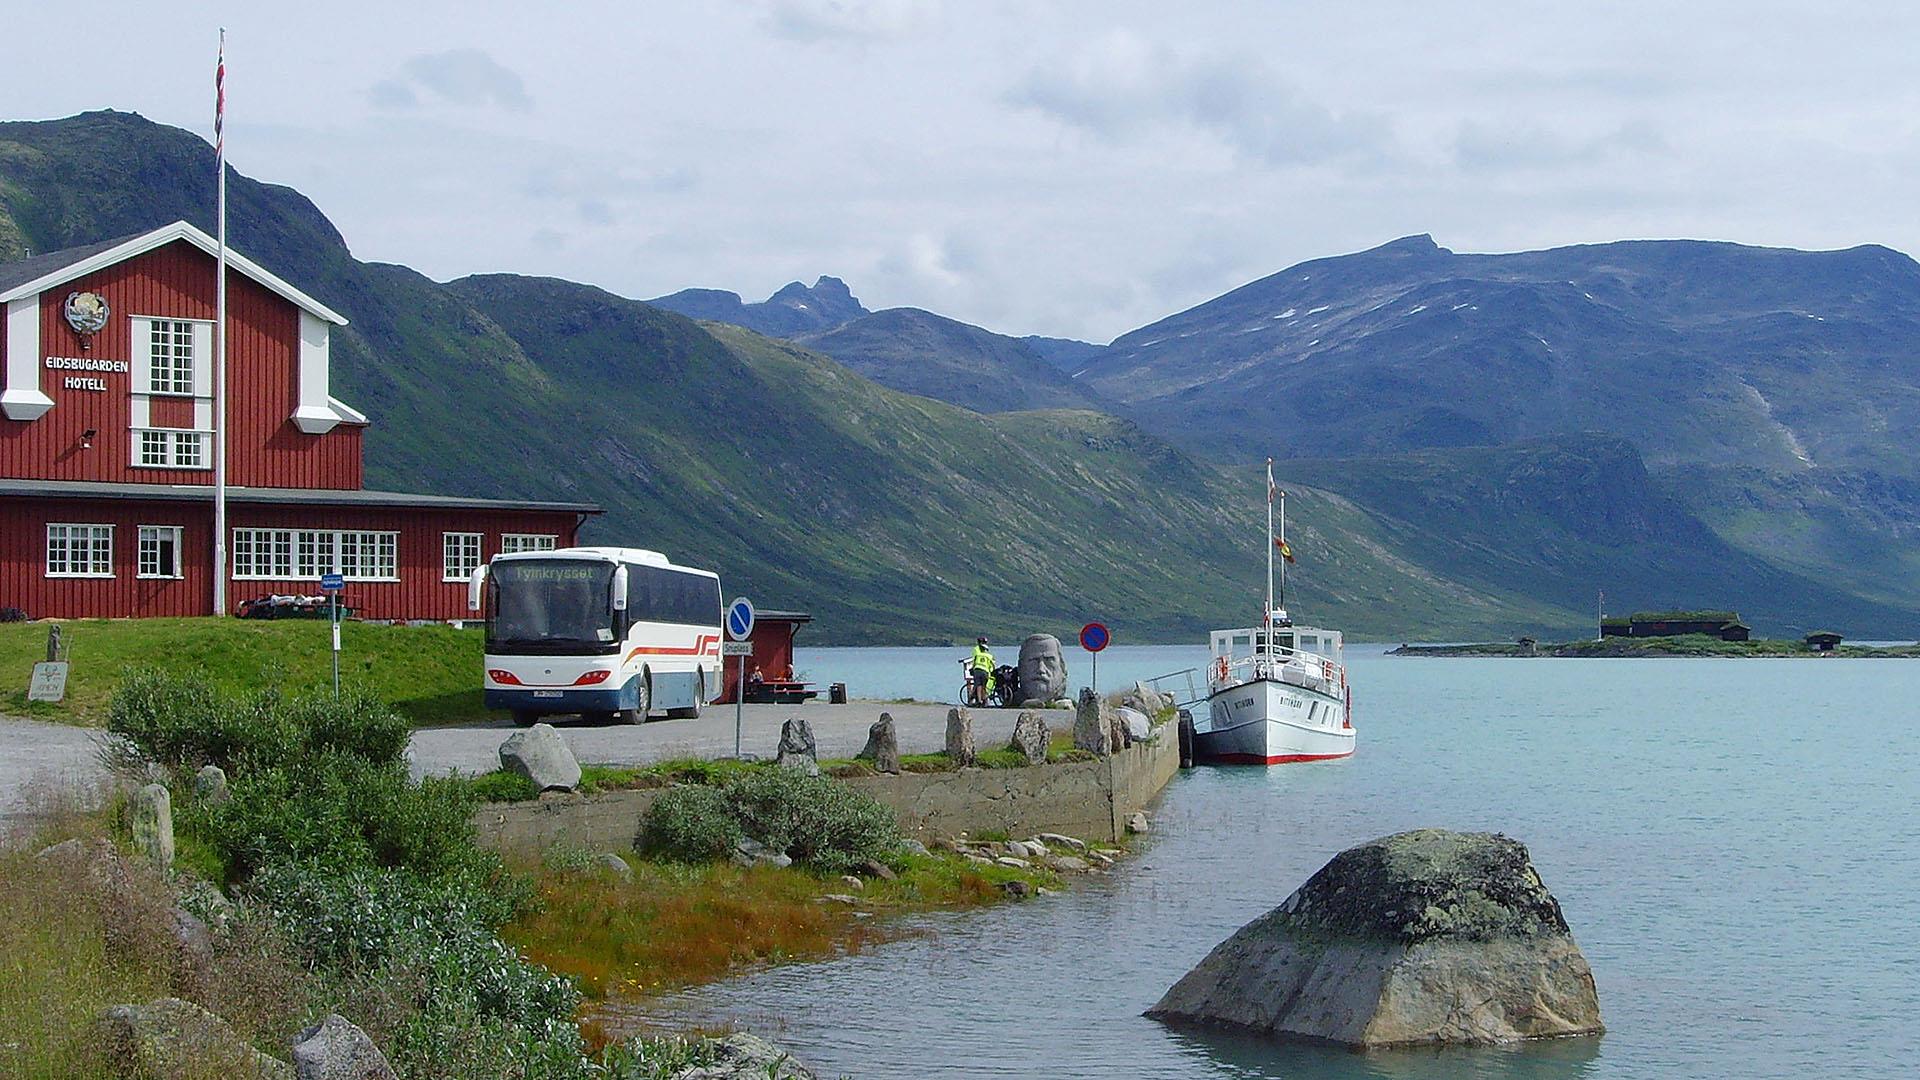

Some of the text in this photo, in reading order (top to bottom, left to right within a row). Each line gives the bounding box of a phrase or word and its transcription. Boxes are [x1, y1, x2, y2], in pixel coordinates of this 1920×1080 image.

[45, 356, 129, 373] EIDSBUGARDEN
[64, 376, 107, 391] HOTELL
[515, 565, 593, 582] Tyinkrysset
